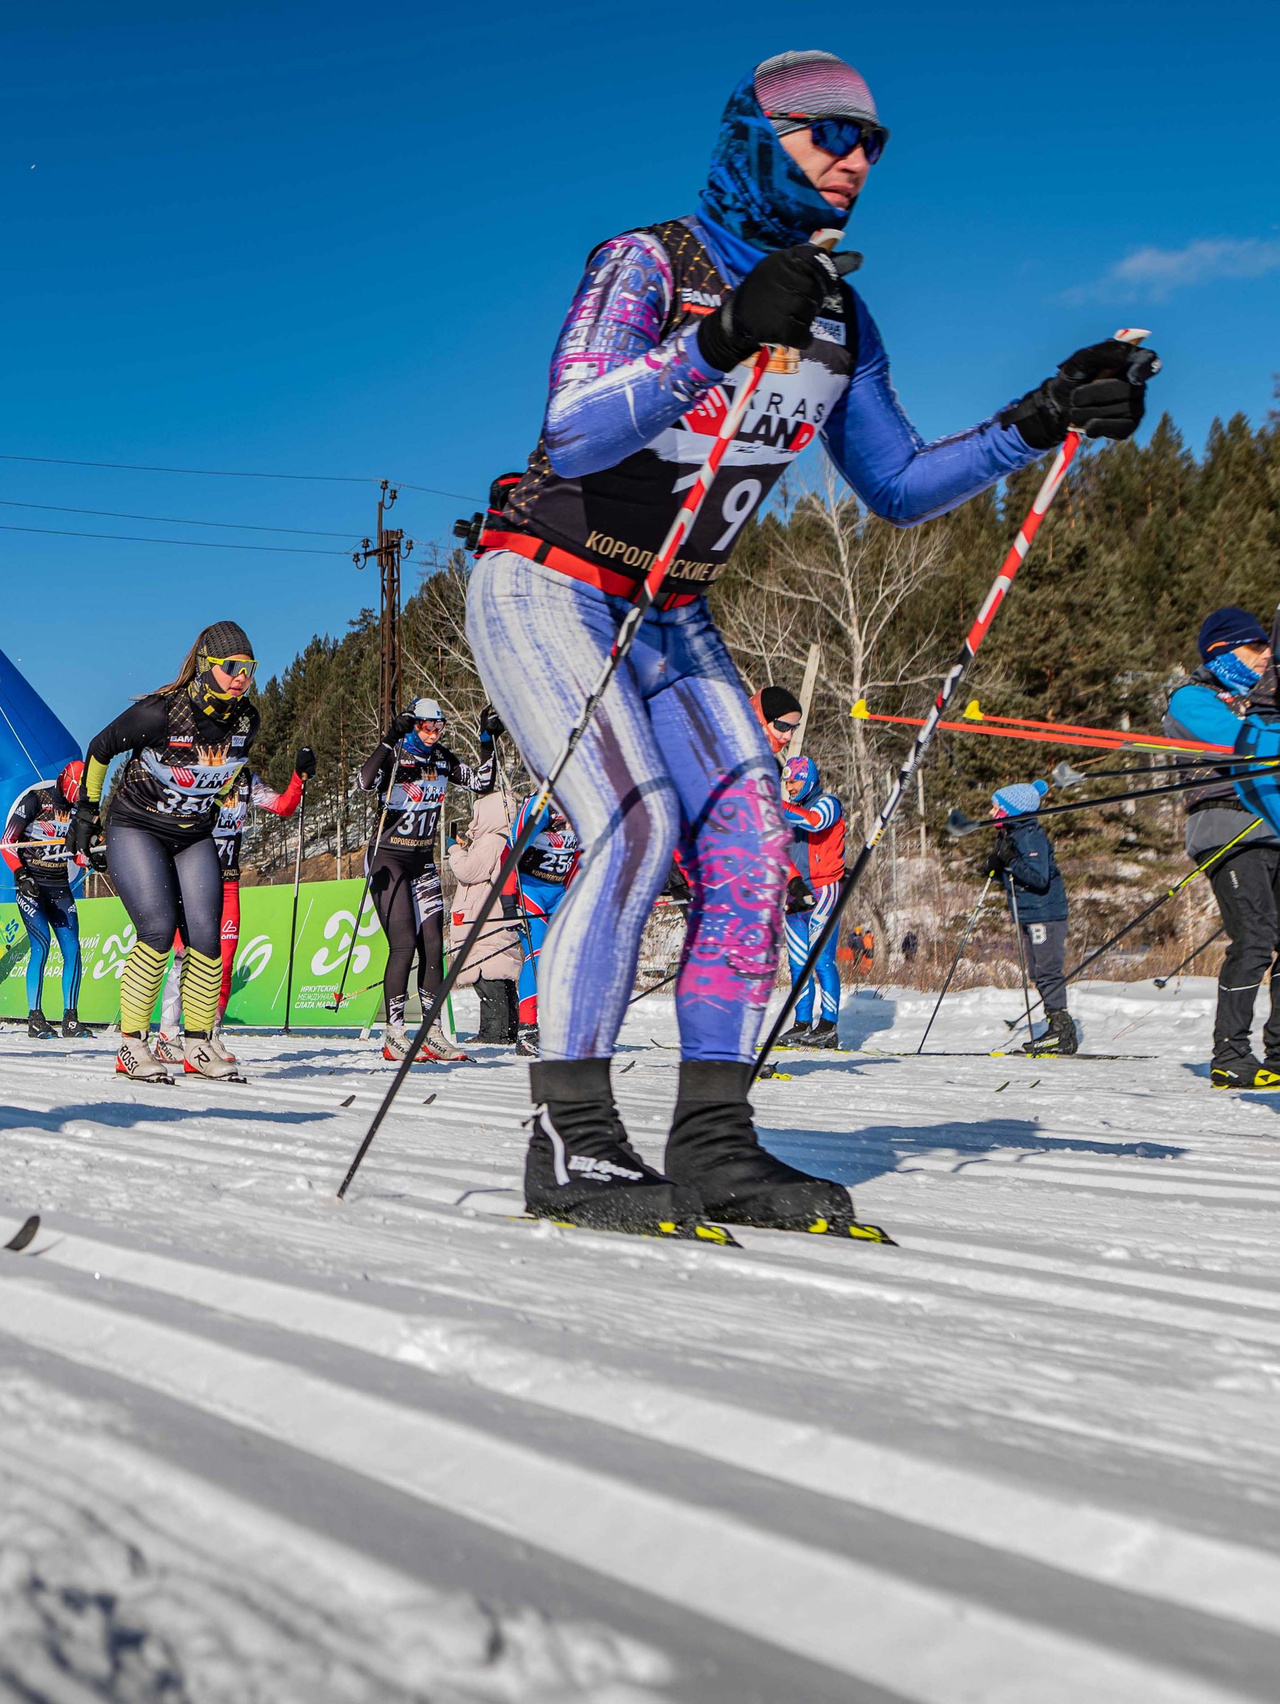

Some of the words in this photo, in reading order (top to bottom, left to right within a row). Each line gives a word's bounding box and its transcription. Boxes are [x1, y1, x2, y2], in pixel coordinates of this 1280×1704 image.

[733, 410, 816, 452] LAND
[584, 529, 713, 582] КОРОЛЕСКИЕ
[397, 811, 437, 837] 319
[301, 983, 339, 993] ИРКУТСКИЙ
[120, 1044, 140, 1074] ROSSI
